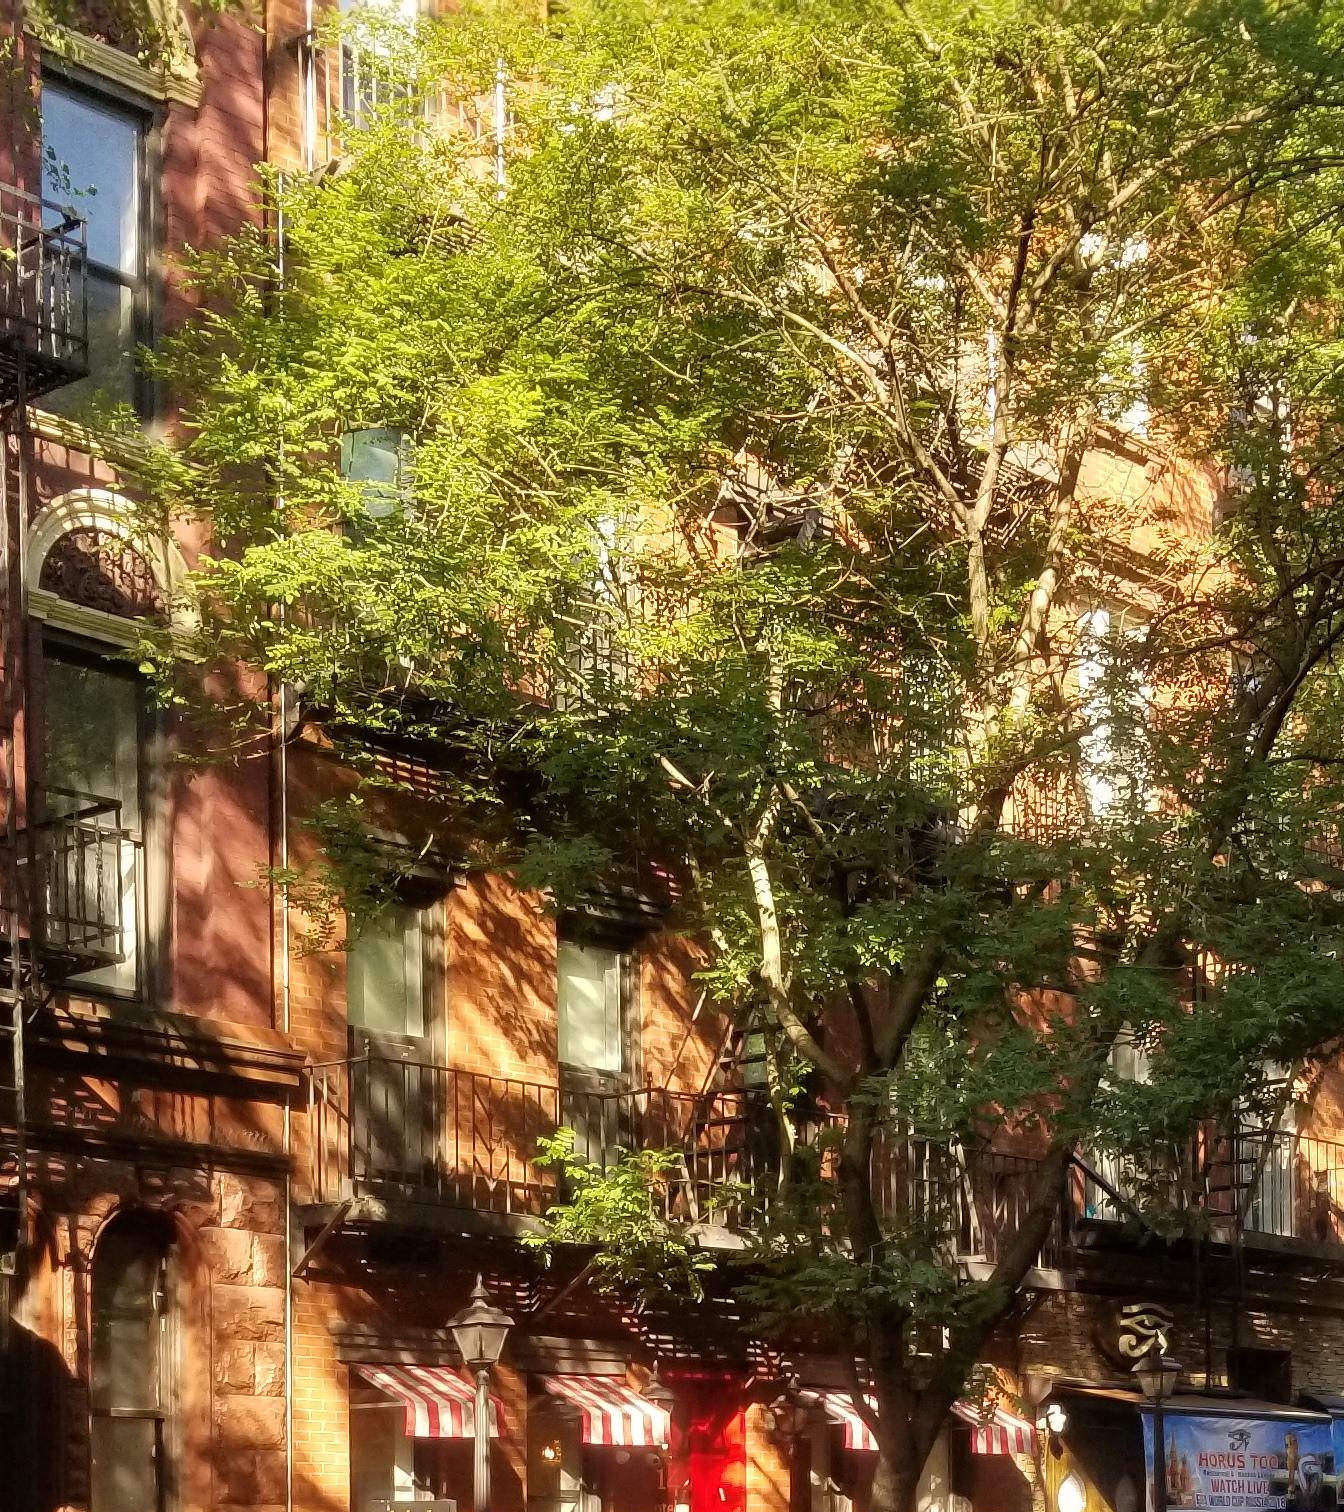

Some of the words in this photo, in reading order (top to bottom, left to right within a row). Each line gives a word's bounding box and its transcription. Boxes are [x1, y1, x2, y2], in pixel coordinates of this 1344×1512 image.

[1199, 1452, 1245, 1469] HORUS
[1250, 1455, 1280, 1469] TOO
[1210, 1479, 1245, 1494] WATCH
[1247, 1480, 1270, 1495] LIVE
